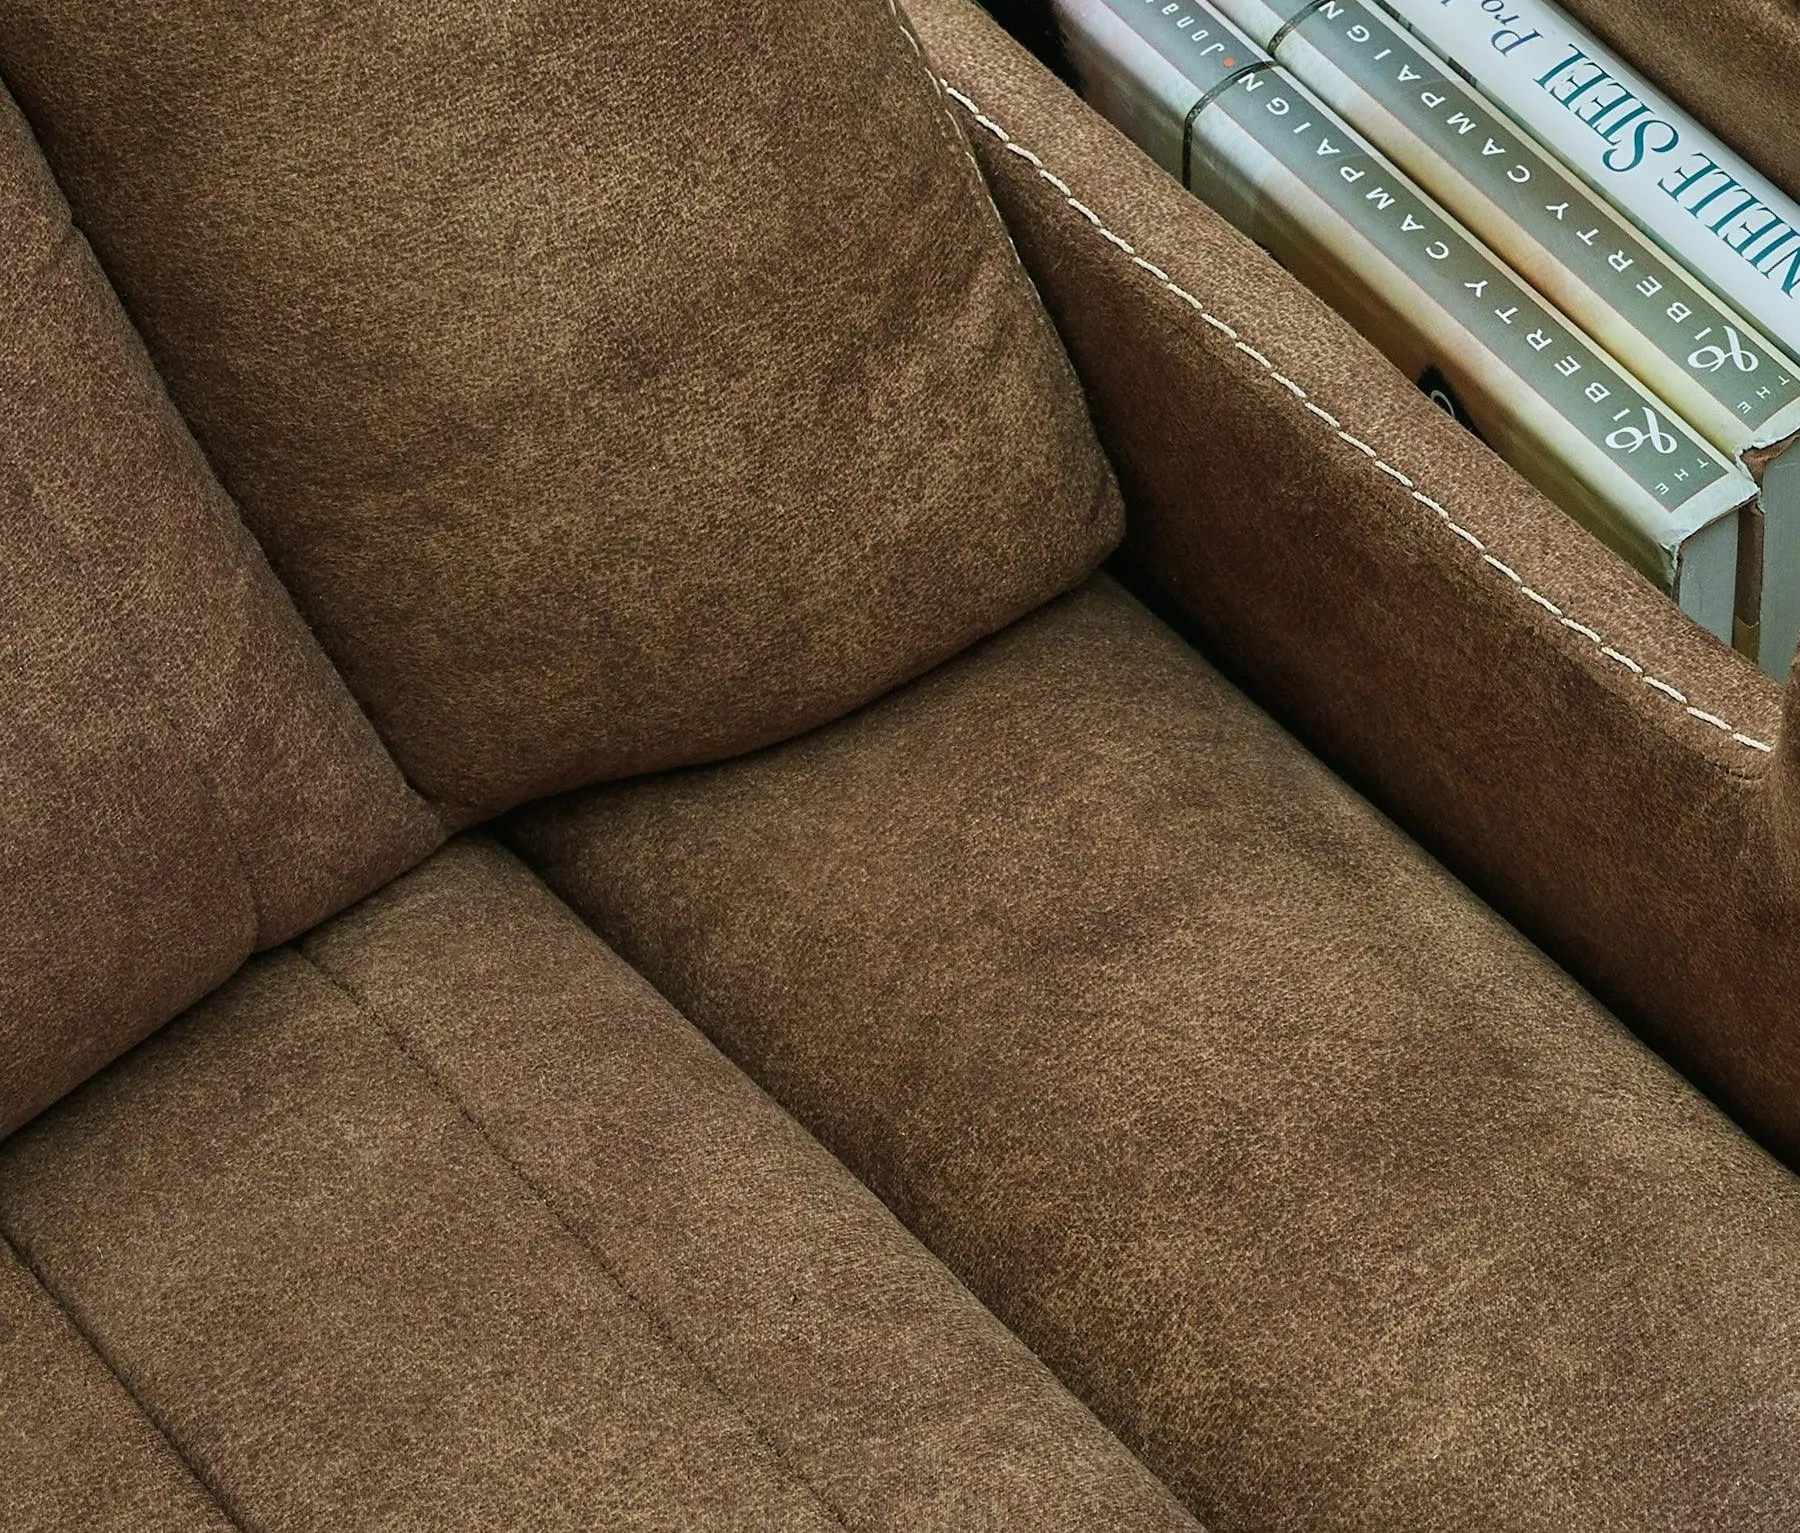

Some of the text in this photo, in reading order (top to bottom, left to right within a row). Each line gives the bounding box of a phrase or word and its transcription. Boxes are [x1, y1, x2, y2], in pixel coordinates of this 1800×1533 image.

[1532, 43, 1680, 172] STEEL
[1318, 0, 1759, 372] LIBERTY CAMPAIGN
[1237, 72, 1678, 454] LIBERTY CAMPAIGN
[1737, 374, 1791, 414] THE
[1655, 457, 1709, 495] THE
